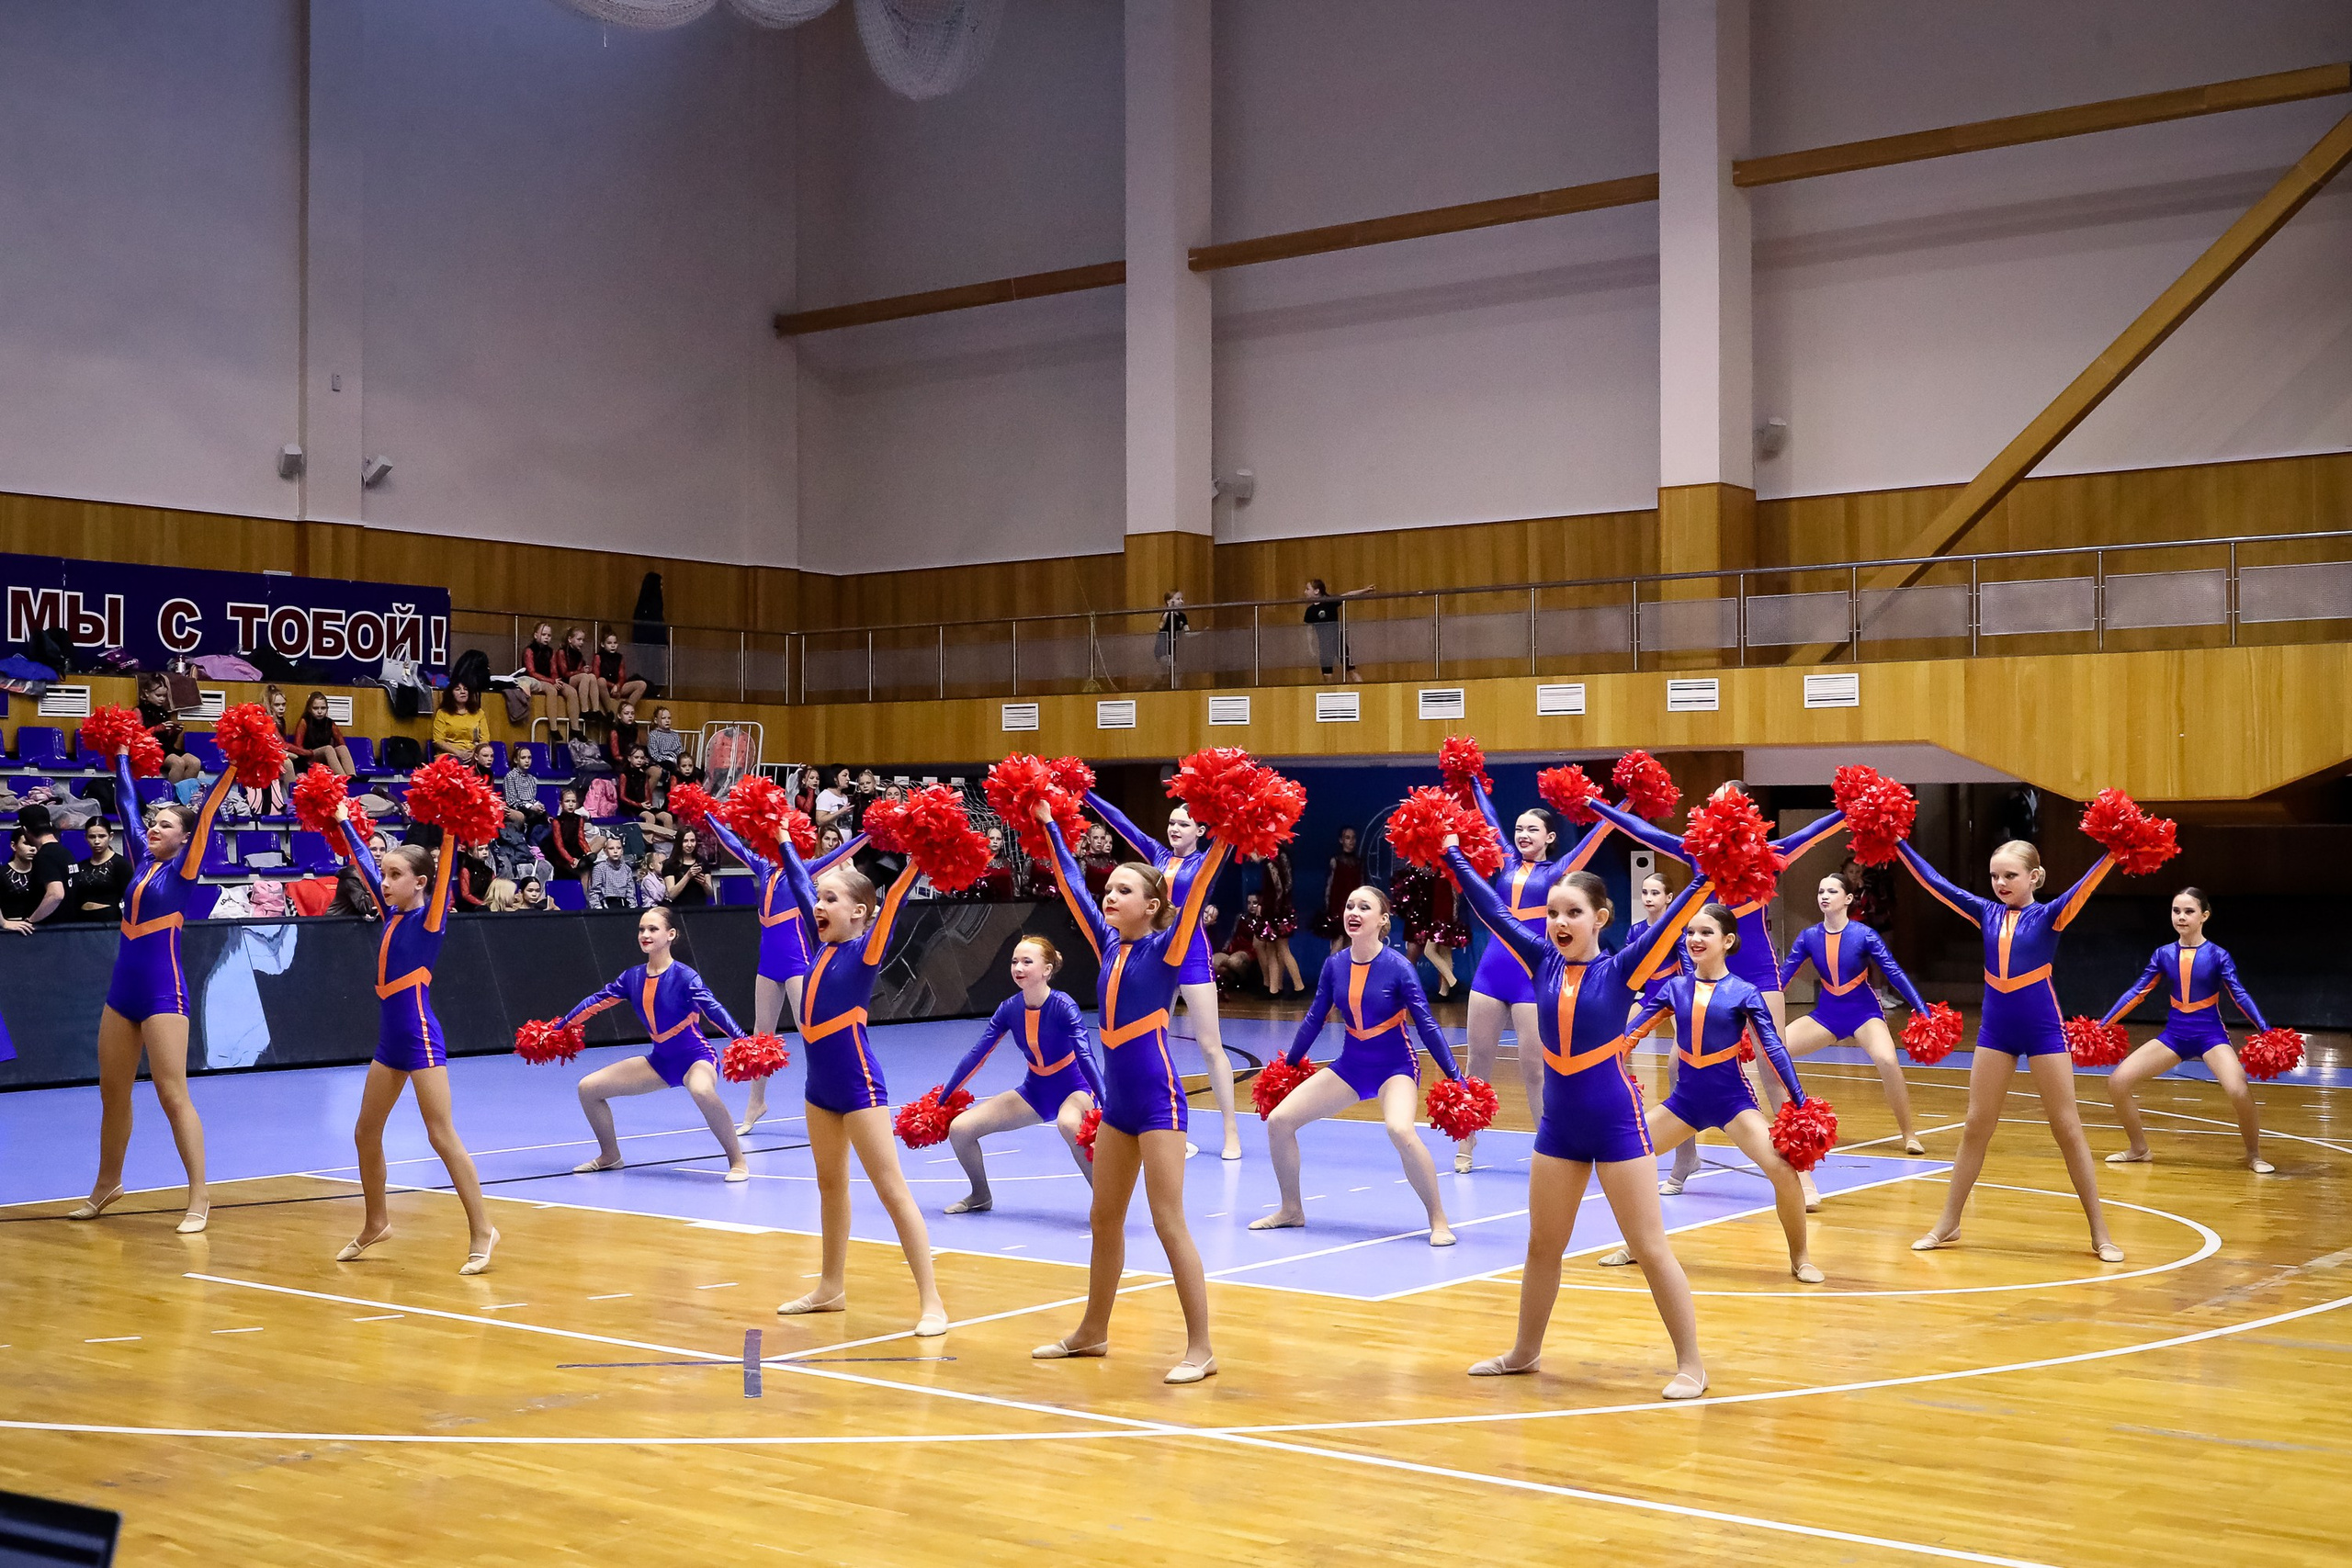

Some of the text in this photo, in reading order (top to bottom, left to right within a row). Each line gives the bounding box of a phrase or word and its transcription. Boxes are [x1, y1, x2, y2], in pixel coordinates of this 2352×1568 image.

[7, 586, 447, 665] МЫ С ТОБОЙ!
